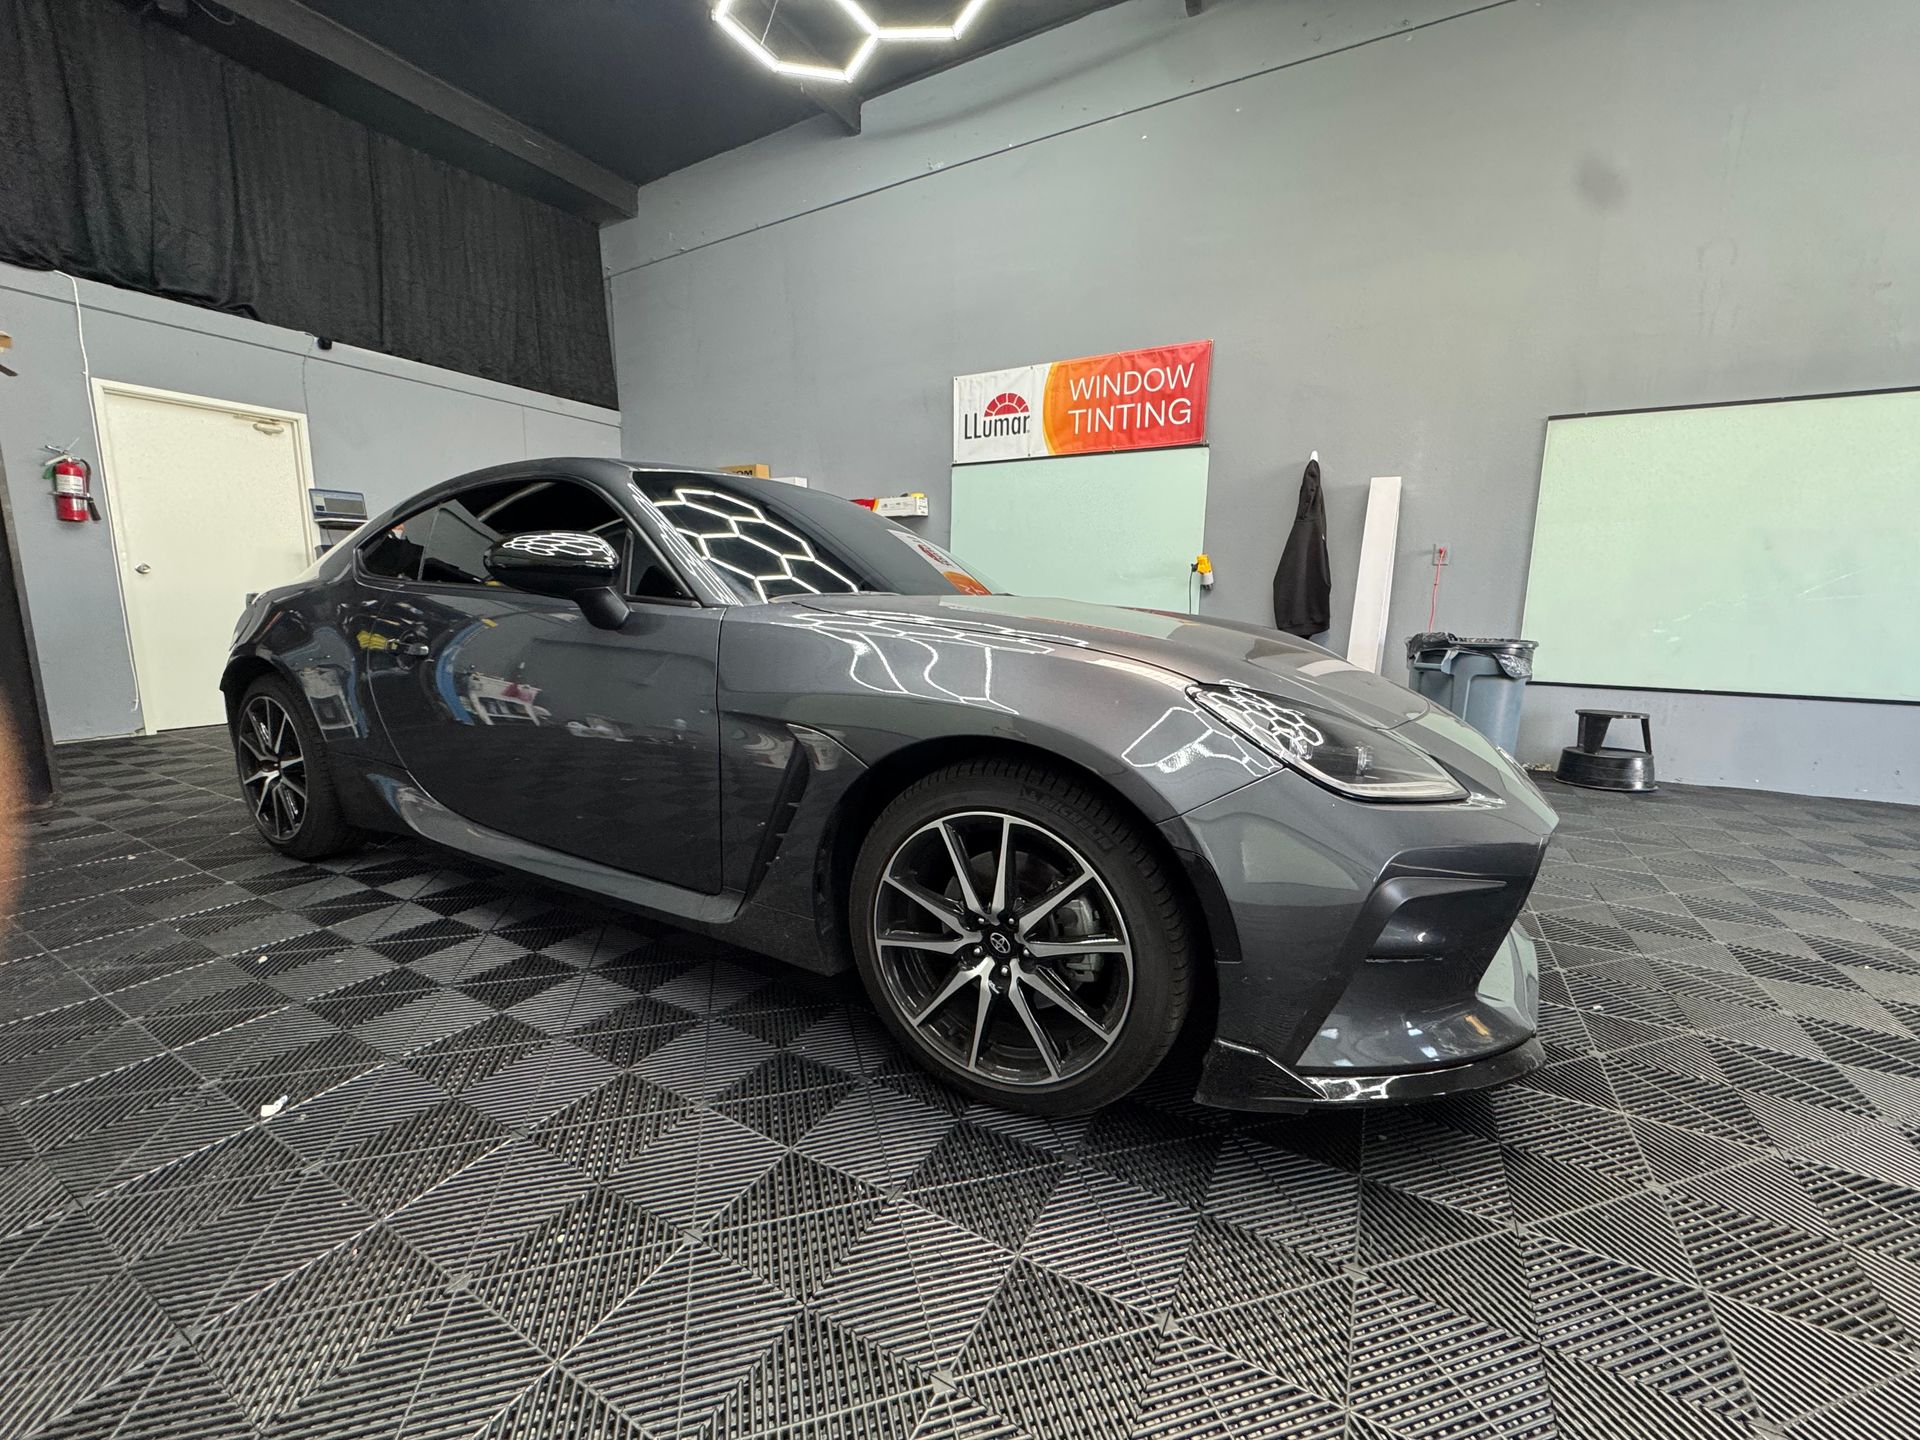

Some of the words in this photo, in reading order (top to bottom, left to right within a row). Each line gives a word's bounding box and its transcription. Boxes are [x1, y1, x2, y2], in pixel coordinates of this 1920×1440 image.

[1069, 362, 1195, 401] WINDOW
[964, 412, 1030, 440] LLumar
[1068, 397, 1192, 435] TINTING
